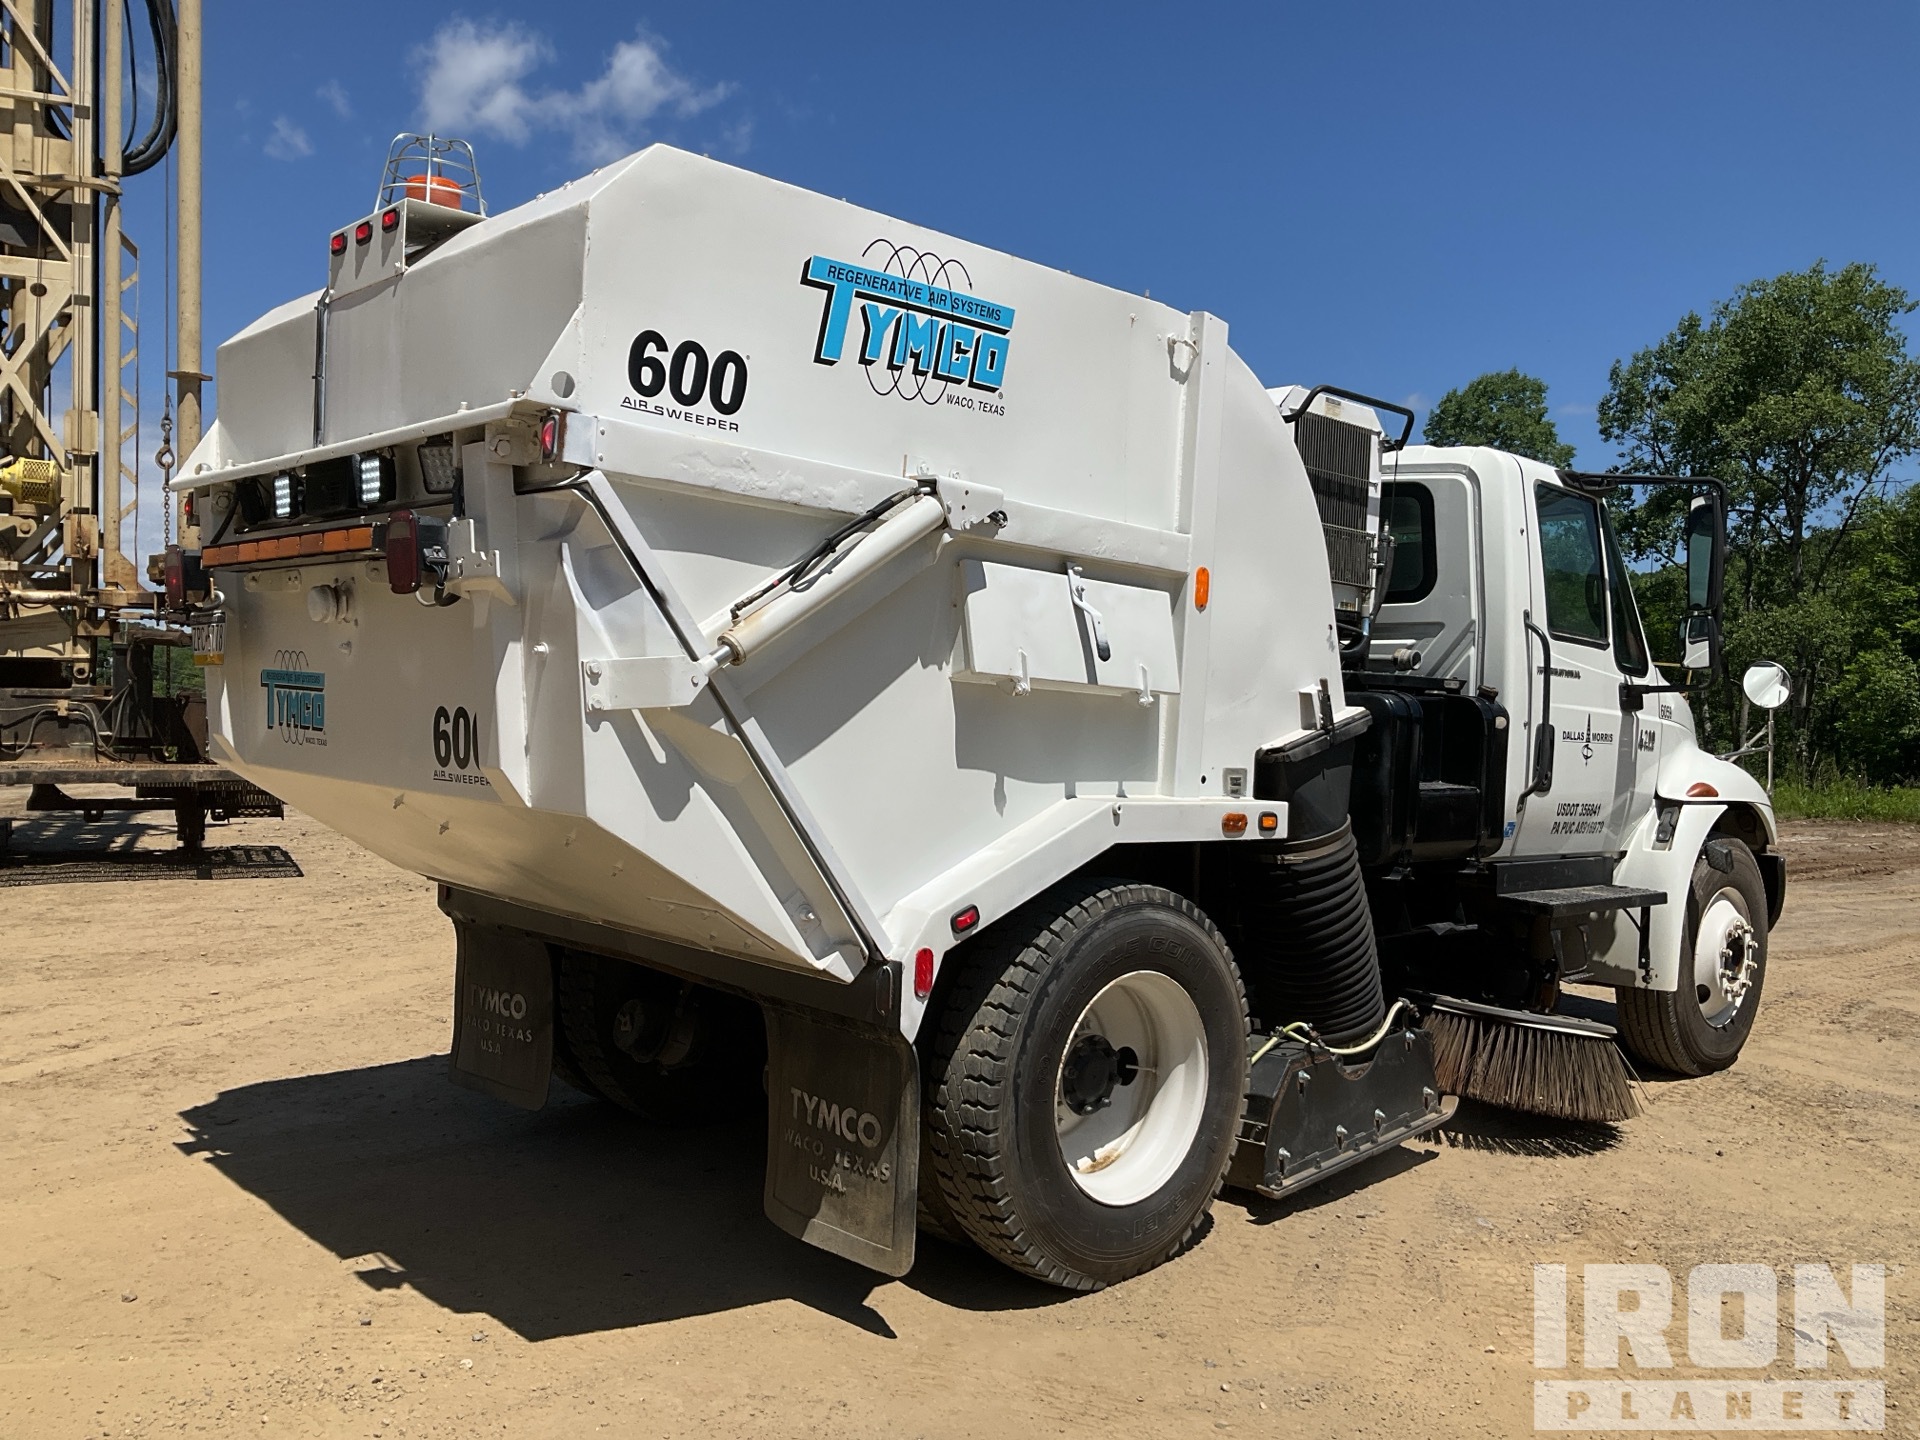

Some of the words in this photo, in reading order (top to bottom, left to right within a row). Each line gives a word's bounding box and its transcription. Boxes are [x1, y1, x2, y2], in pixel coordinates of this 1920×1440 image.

[827, 265, 922, 300] REGENERATIVE
[928, 290, 948, 307] AIR
[951, 296, 1001, 322] SYSTEMS
[800, 255, 1015, 393] TYMCO
[628, 329, 748, 416] 600
[621, 396, 648, 410] AIR
[654, 405, 739, 433] SWEEPER
[946, 393, 975, 411] WACO,
[977, 400, 1005, 417] TEXAS
[261, 669, 325, 732] TYMCO
[1562, 730, 1585, 741] DALLAS
[1592, 732, 1613, 743] MORRIS
[433, 769, 446, 778] AIR
[1550, 821, 1561, 834] PA
[1560, 821, 1576, 834] PUC
[1556, 802, 1580, 816] USDOT
[470, 983, 527, 1020] TYMCO
[1049, 936, 1140, 1044] DOUBLE
[1147, 935, 1203, 974] COIN
[496, 1023, 533, 1043] TEXAS
[790, 1087, 882, 1148] TYMCO
[834, 1147, 890, 1182] TEXAS
